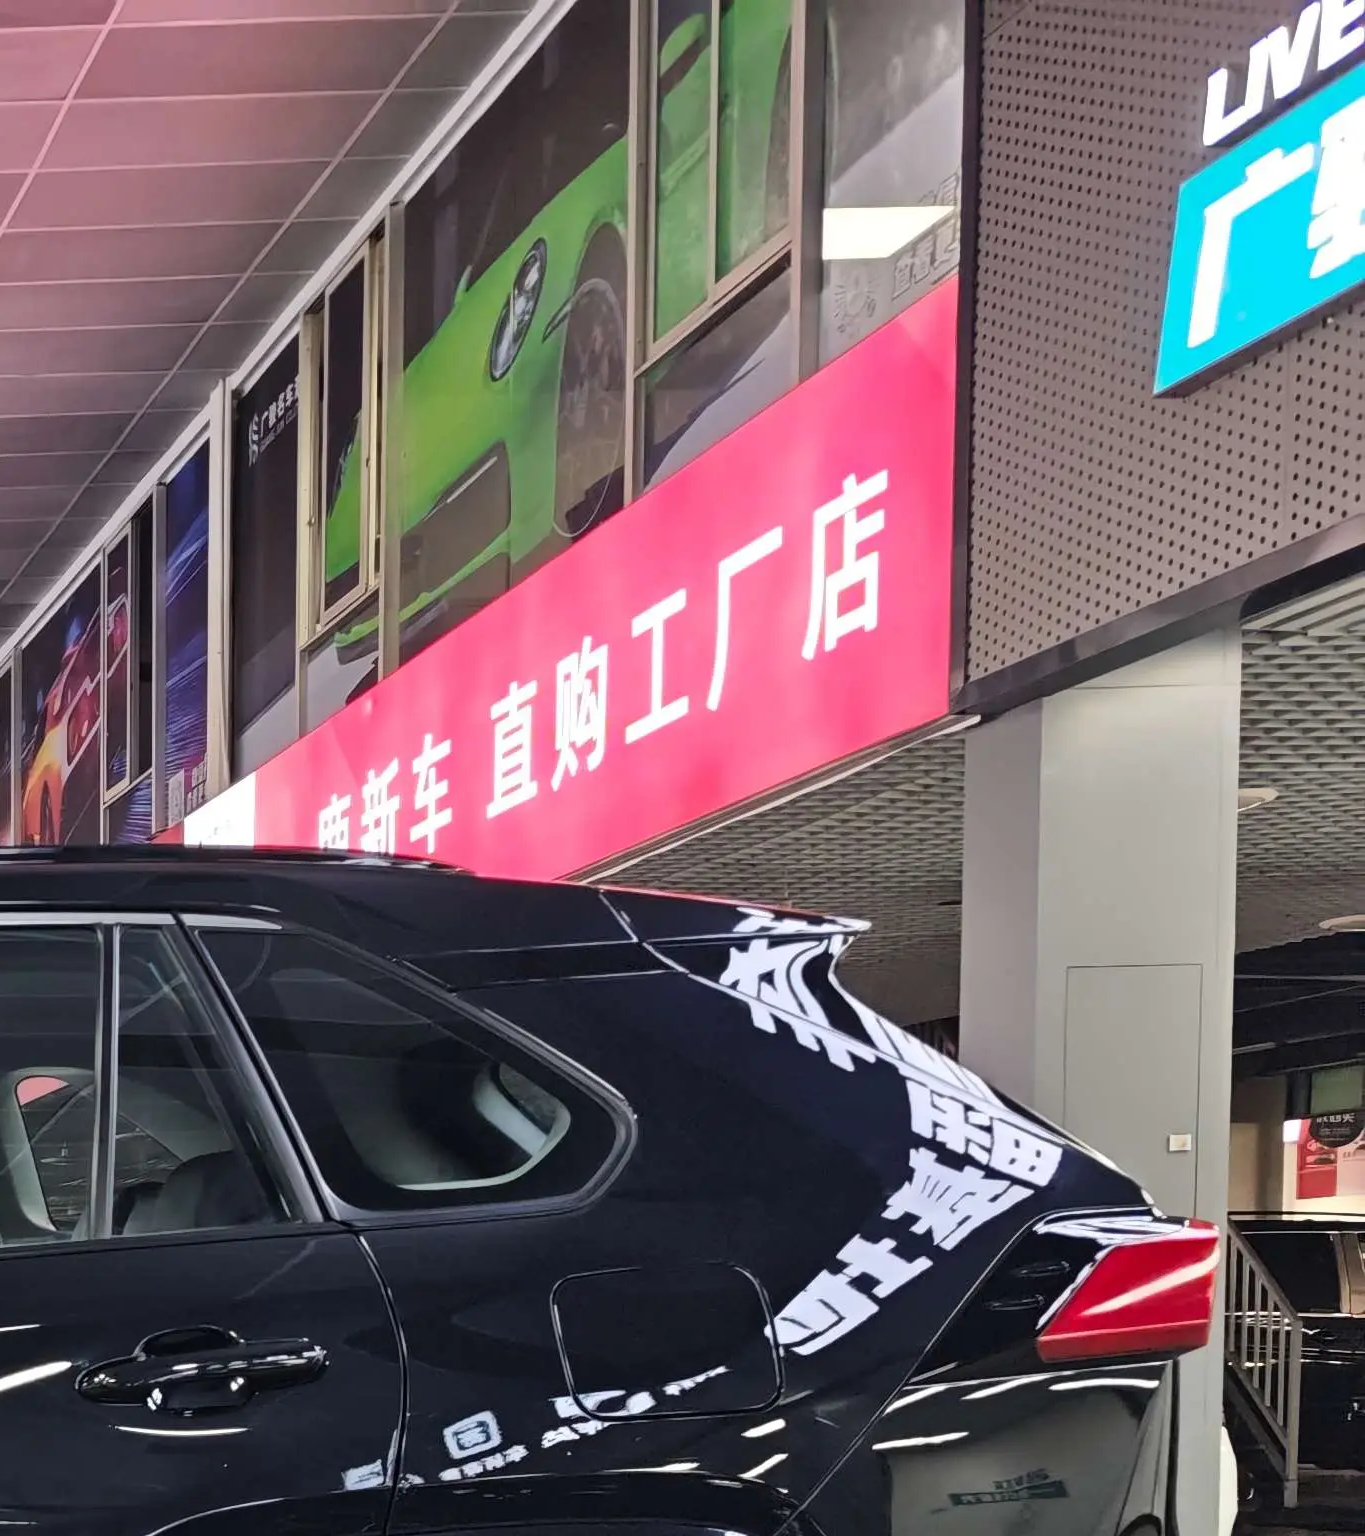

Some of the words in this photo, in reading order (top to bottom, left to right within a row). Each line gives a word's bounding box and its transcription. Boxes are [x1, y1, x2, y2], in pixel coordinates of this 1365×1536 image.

[486, 470, 890, 819] 直购工厂店
